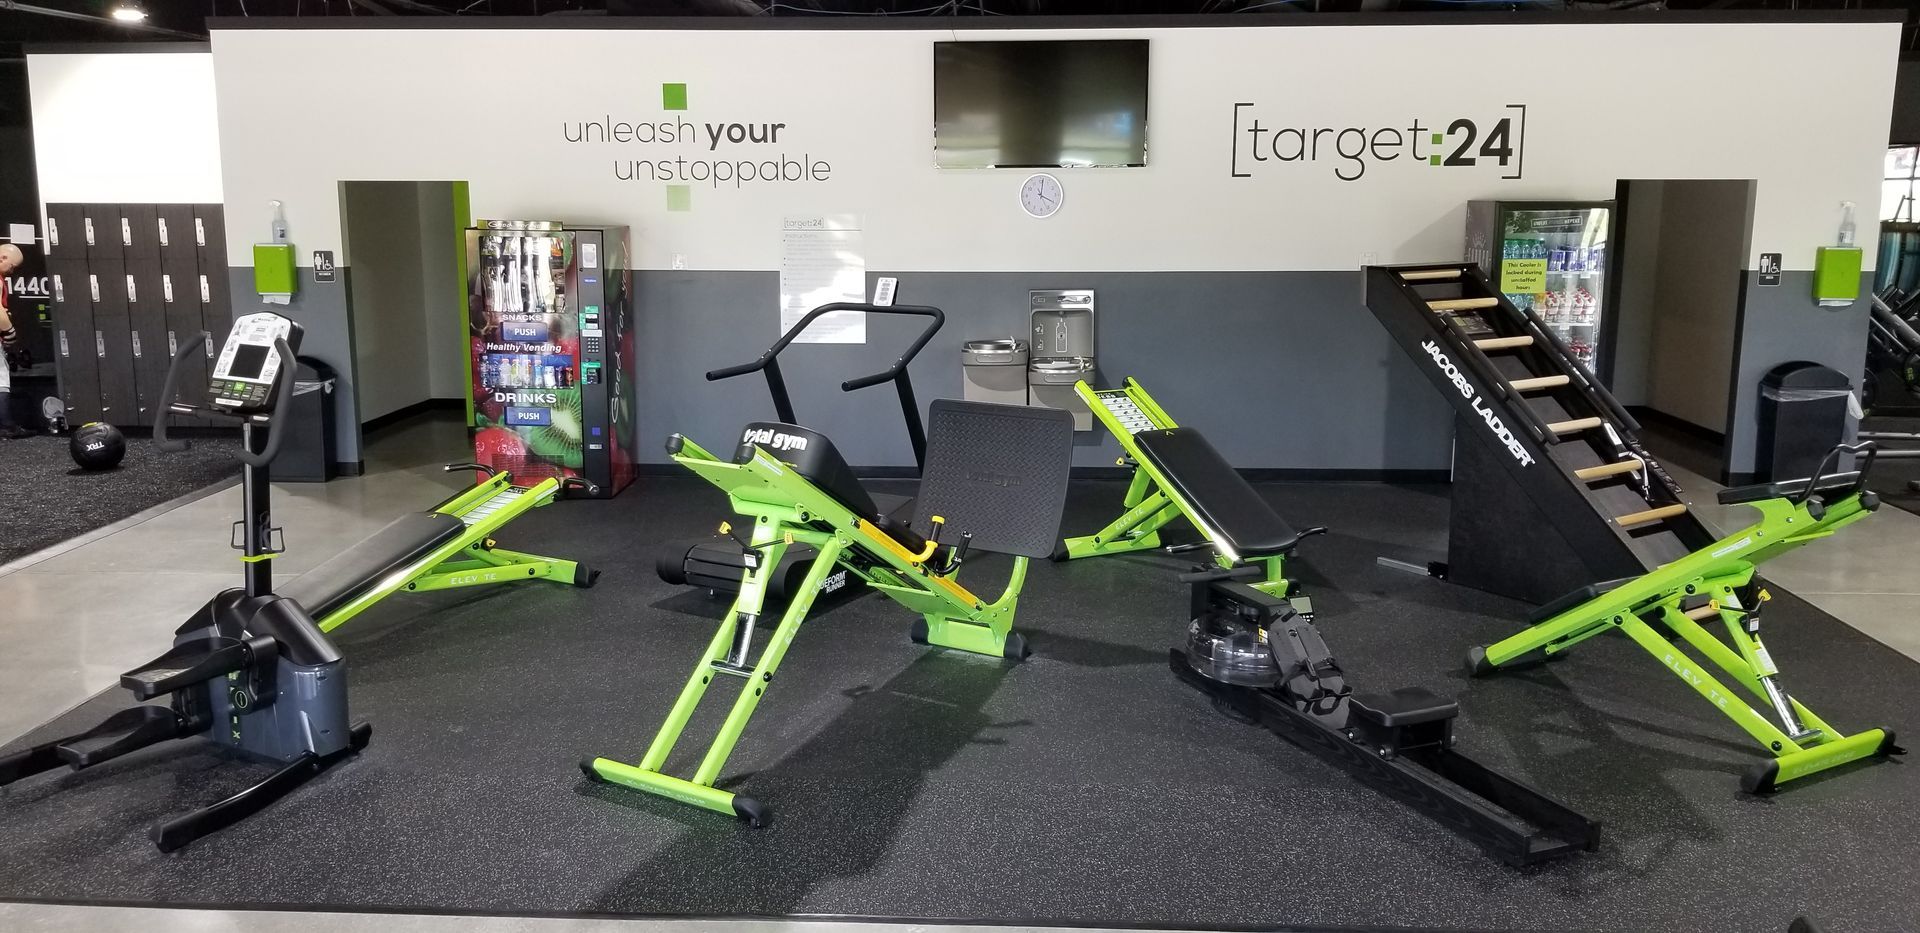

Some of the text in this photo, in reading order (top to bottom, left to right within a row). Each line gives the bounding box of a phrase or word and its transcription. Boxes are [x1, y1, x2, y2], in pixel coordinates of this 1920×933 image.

[564, 115, 786, 151] unleash your
[615, 153, 831, 188] unstoppable
[514, 328, 537, 336] PUSH
[486, 342, 562, 353] Healthy Vending
[495, 392, 557, 404] DRINKS
[1421, 340, 1531, 467] JACOBS LADDER
[518, 412, 540, 420] PUSH
[86, 441, 105, 452] TRX
[743, 429, 808, 451] total gym
[826, 579, 846, 593] RUNNER
